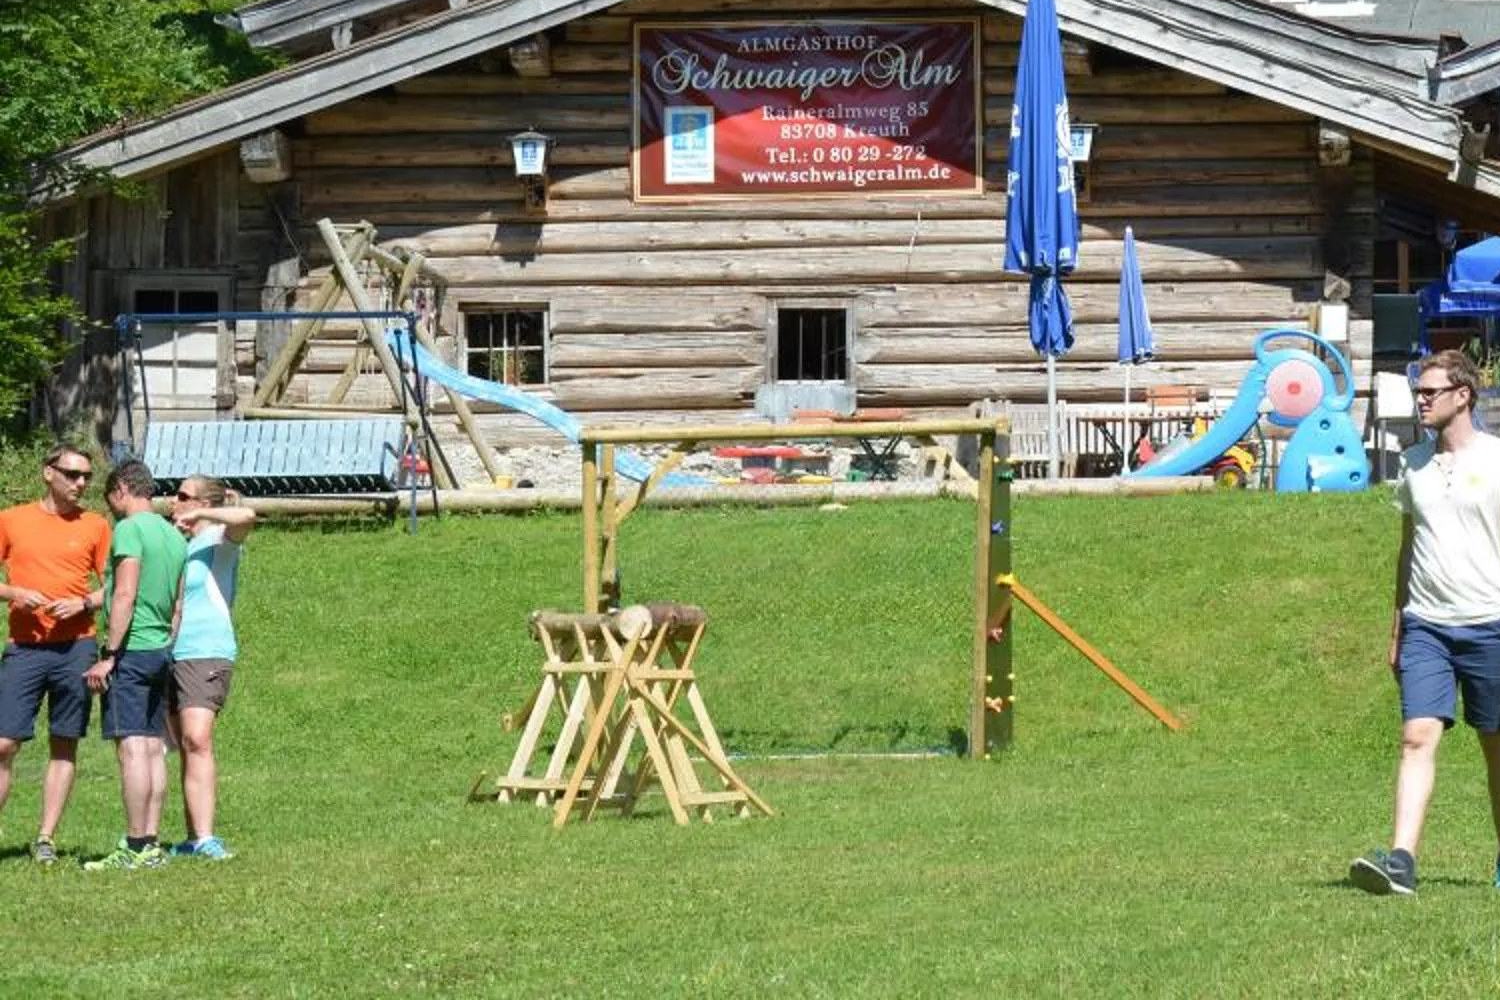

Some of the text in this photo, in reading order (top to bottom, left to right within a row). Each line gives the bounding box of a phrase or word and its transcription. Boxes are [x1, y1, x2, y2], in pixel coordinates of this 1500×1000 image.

[737, 34, 879, 53] ALMGASTHOF
[653, 44, 961, 100] Schwaiger Alm
[762, 101, 929, 122] Raineralmweg 85
[844, 122, 910, 138] Kreuth
[766, 147, 808, 164] Tel.:
[813, 147, 825, 162] 0
[829, 146, 852, 162] 80
[858, 146, 881, 161] 29
[741, 163, 951, 186] www.schwaigeralm.de
